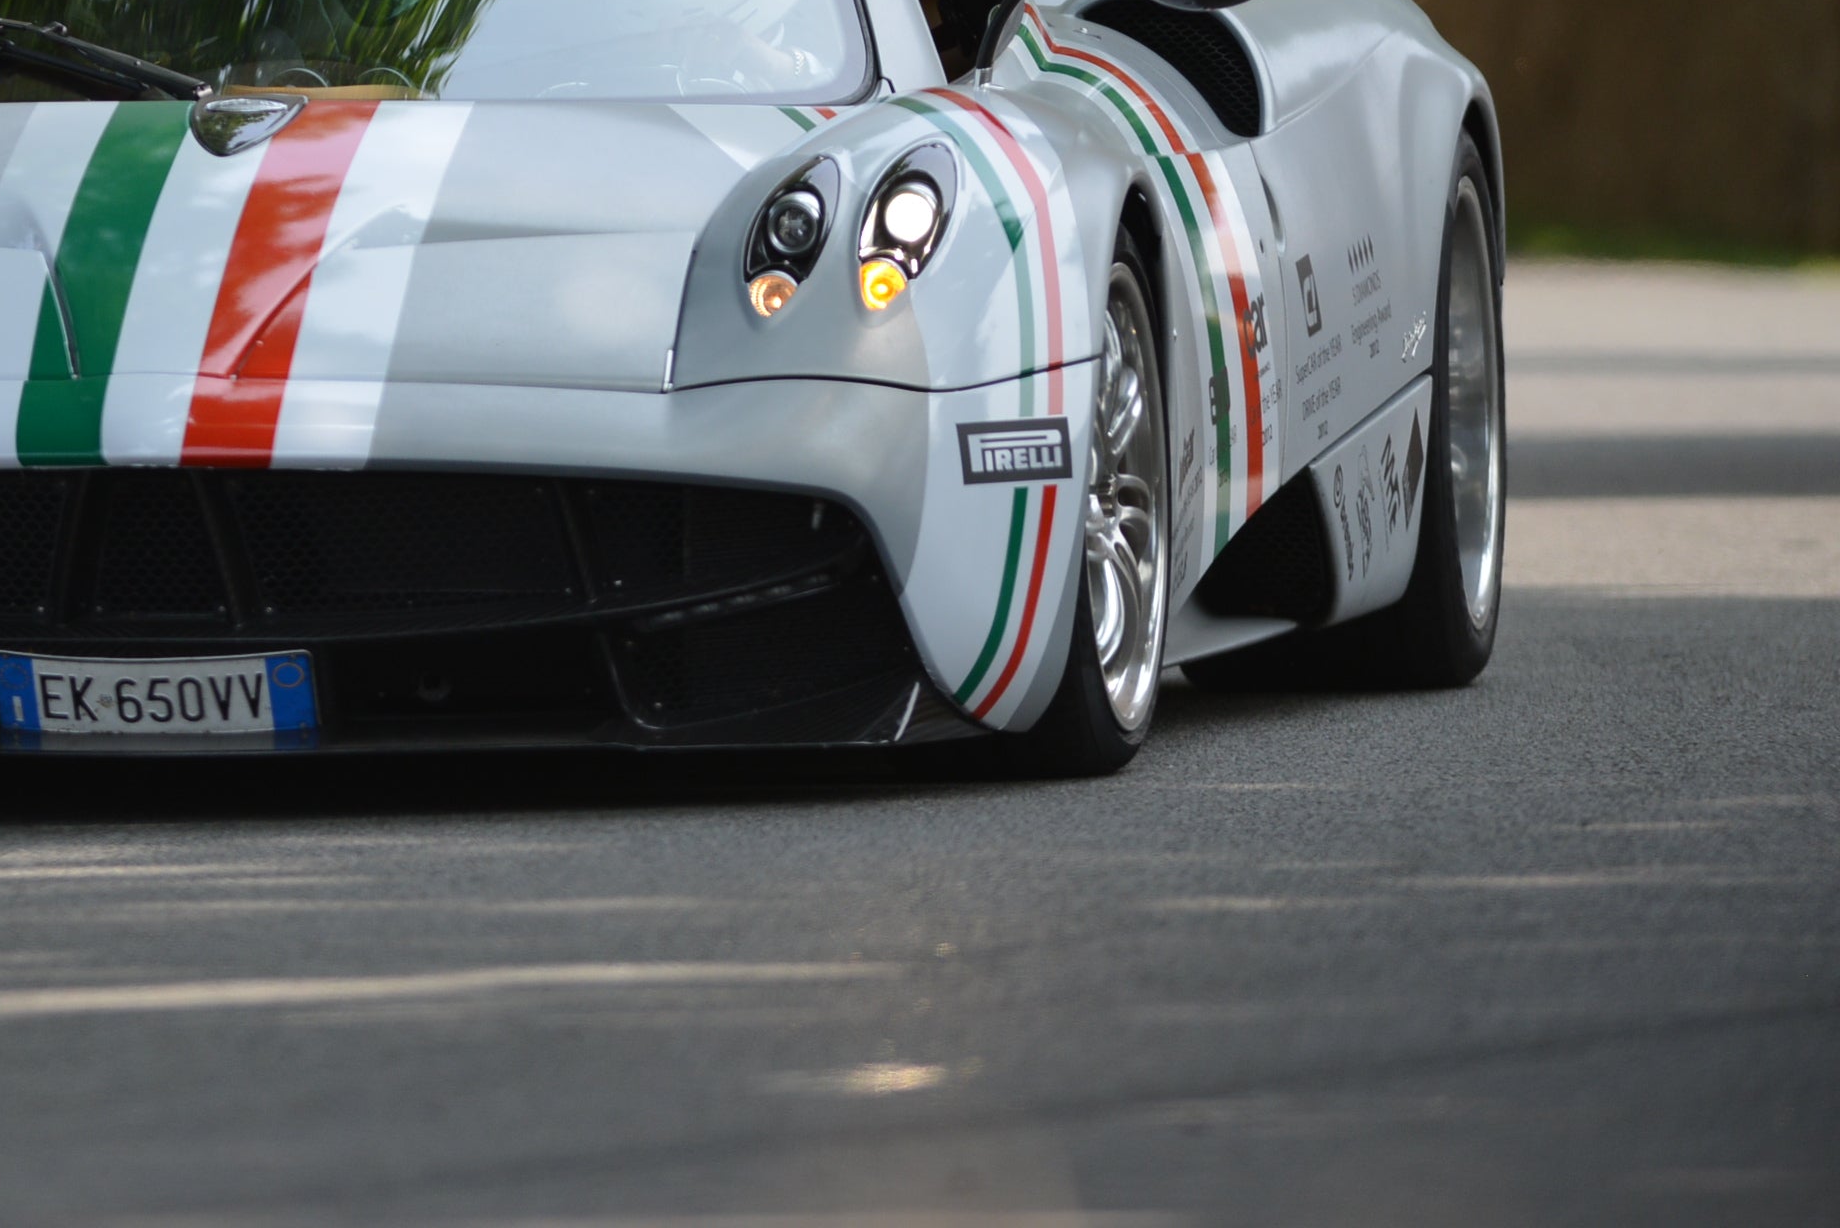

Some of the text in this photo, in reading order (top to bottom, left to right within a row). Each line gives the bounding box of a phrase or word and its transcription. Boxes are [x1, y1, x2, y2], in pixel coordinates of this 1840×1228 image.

[1243, 291, 1268, 360] car
[967, 429, 1063, 473] PIRELLI
[39, 674, 98, 722] EK
[115, 675, 263, 723] 650VV
